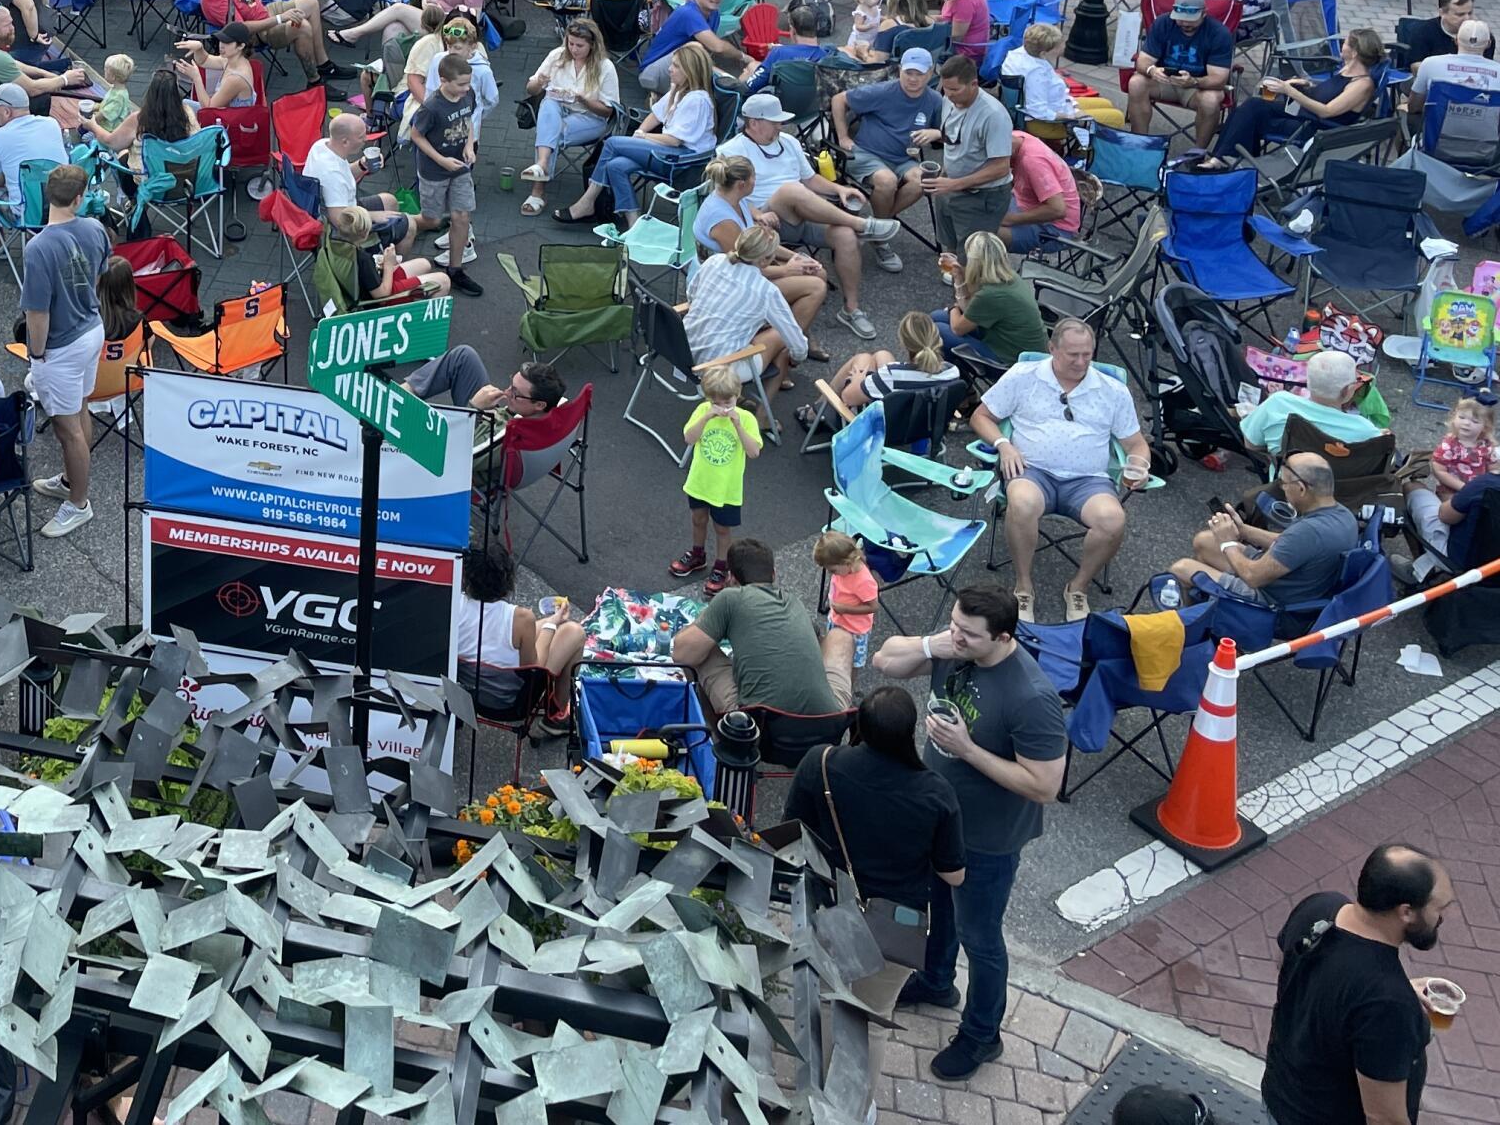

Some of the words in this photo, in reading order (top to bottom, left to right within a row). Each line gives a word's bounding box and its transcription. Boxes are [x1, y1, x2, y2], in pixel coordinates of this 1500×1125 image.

[243, 297, 260, 318] S
[423, 297, 452, 322] AVE
[106, 340, 125, 361] S
[316, 310, 412, 371] JONES
[334, 365, 406, 439] WHITE
[425, 407, 447, 437] ST
[187, 399, 348, 452] CAPITAL
[215, 434, 251, 448] WAKE
[252, 439, 298, 456] FOREST,
[301, 447, 319, 457] NC
[246, 469, 283, 478] CHEVROLET
[295, 468, 315, 477] FIND
[317, 471, 336, 480] NEW
[262, 507, 348, 530] 919-568-1964
[168, 527, 291, 556] MEMBERSHIPS
[293, 546, 388, 571] AVAILAE
[391, 559, 436, 576] NOW
[264, 622, 358, 645] YGunRange.co
[378, 739, 422, 758] Villag
